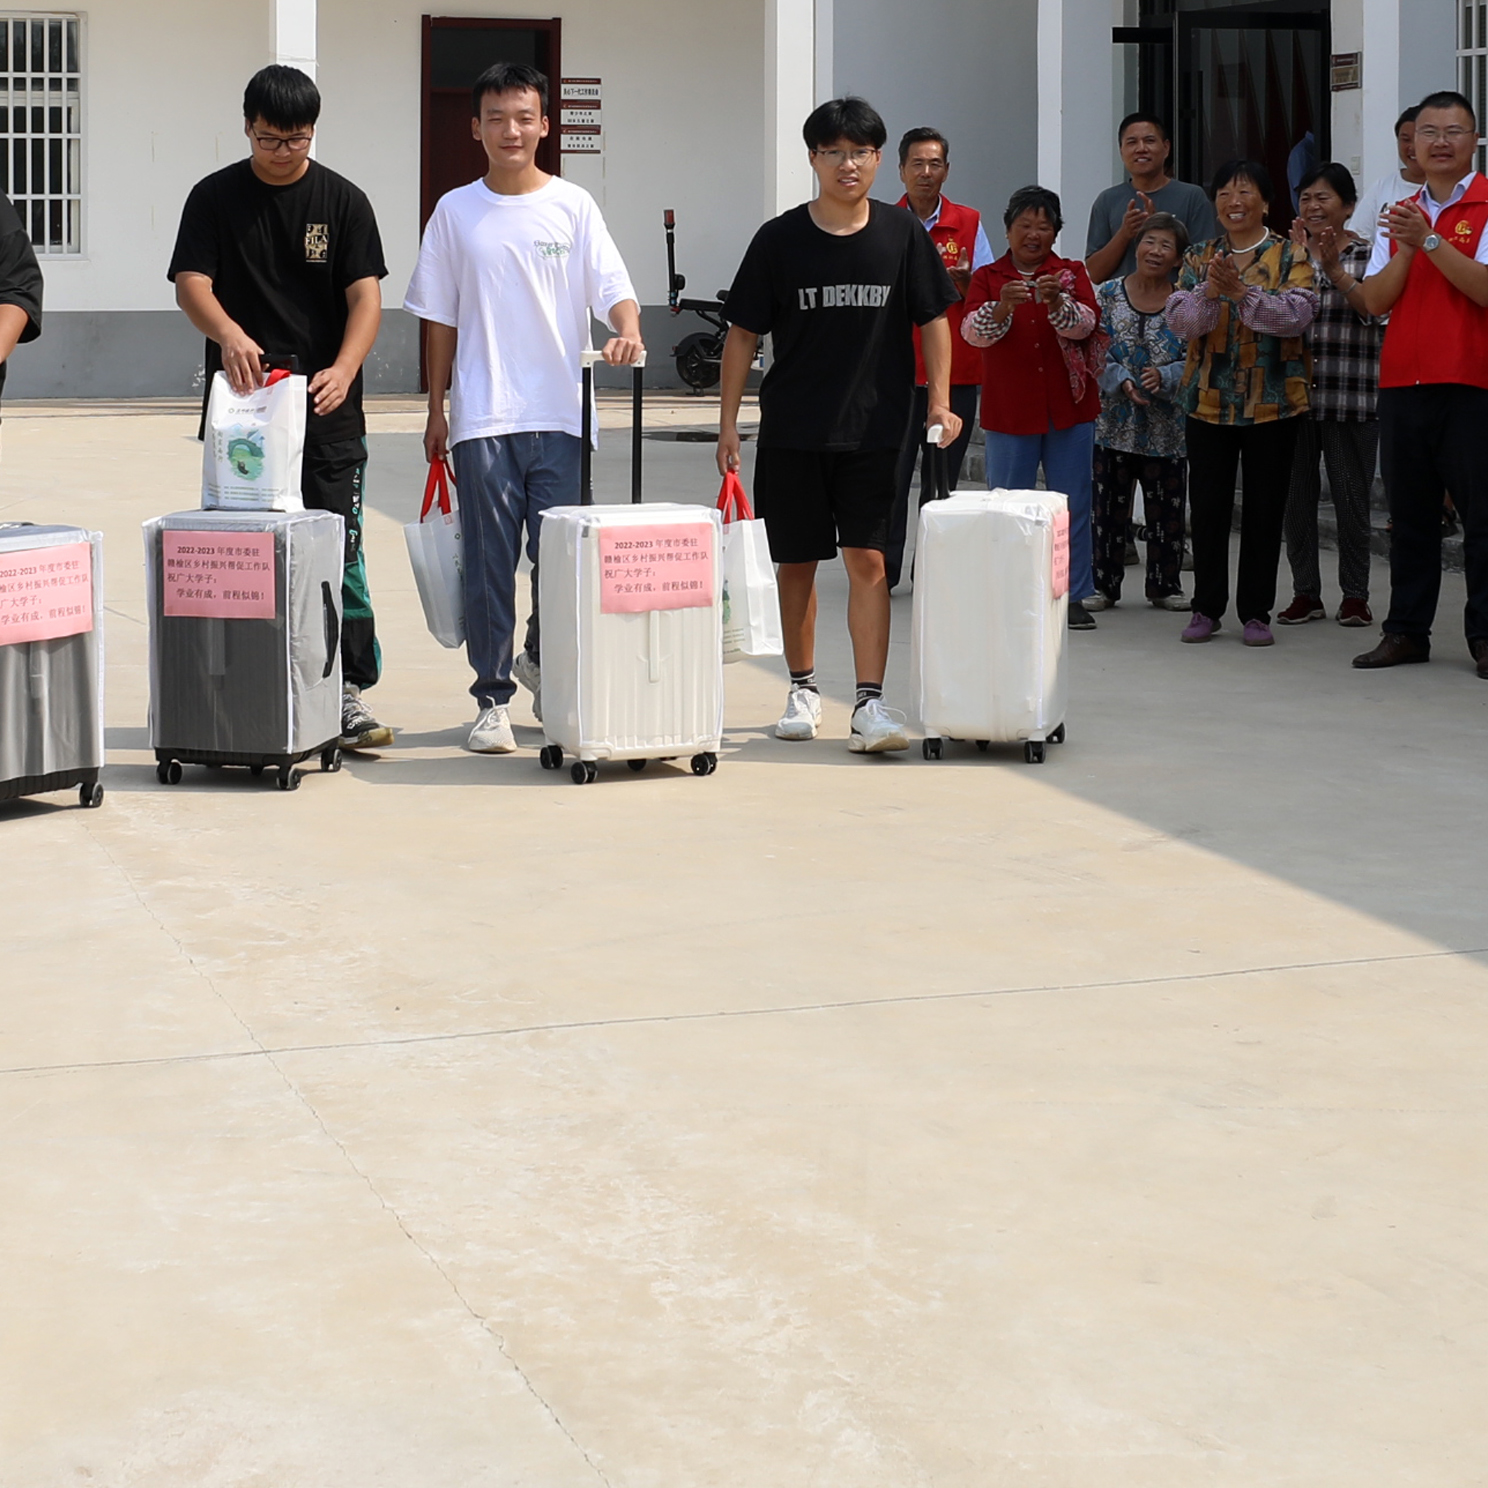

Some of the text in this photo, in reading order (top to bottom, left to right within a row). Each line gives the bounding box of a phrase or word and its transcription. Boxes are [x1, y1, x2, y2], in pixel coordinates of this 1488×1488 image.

[798, 284, 891, 310] LT DEKKBY
[614, 541, 653, 550] 2022-2023
[177, 546, 215, 555] 2022-2023
